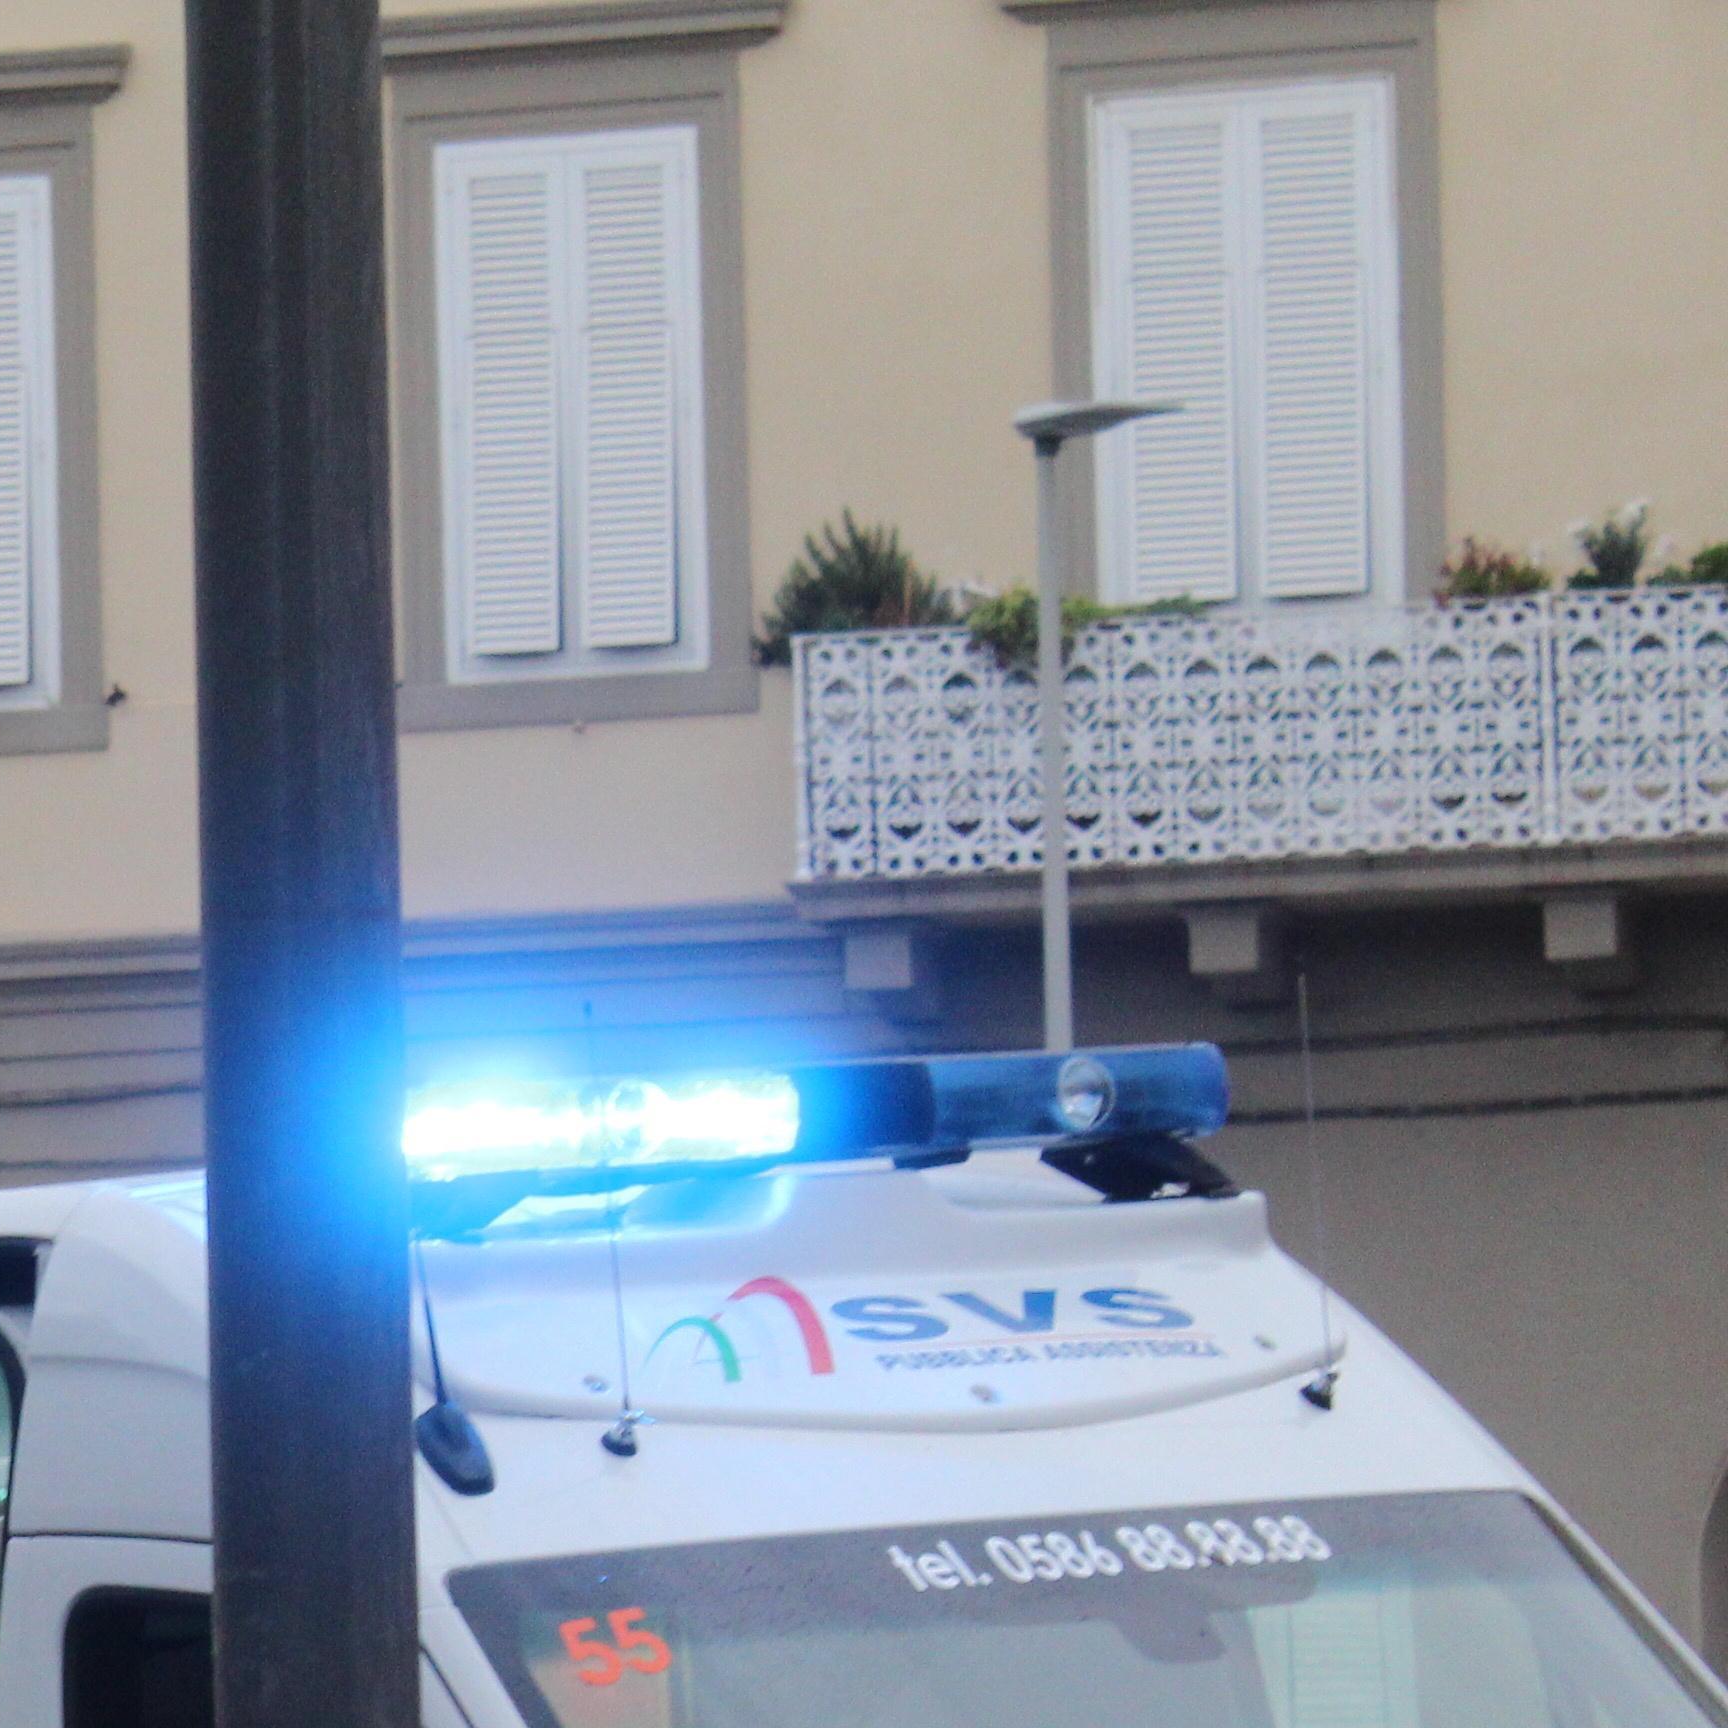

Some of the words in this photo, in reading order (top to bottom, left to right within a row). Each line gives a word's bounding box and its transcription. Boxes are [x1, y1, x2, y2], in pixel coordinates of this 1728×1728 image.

[831, 1287, 1193, 1341] SVS
[875, 1345, 1035, 1371] PUBBLICA
[1044, 1340, 1226, 1361] ASSISTENZA
[887, 1540, 993, 1592] tel.
[985, 1531, 1123, 1584] 0586
[559, 1606, 673, 1687] 55
